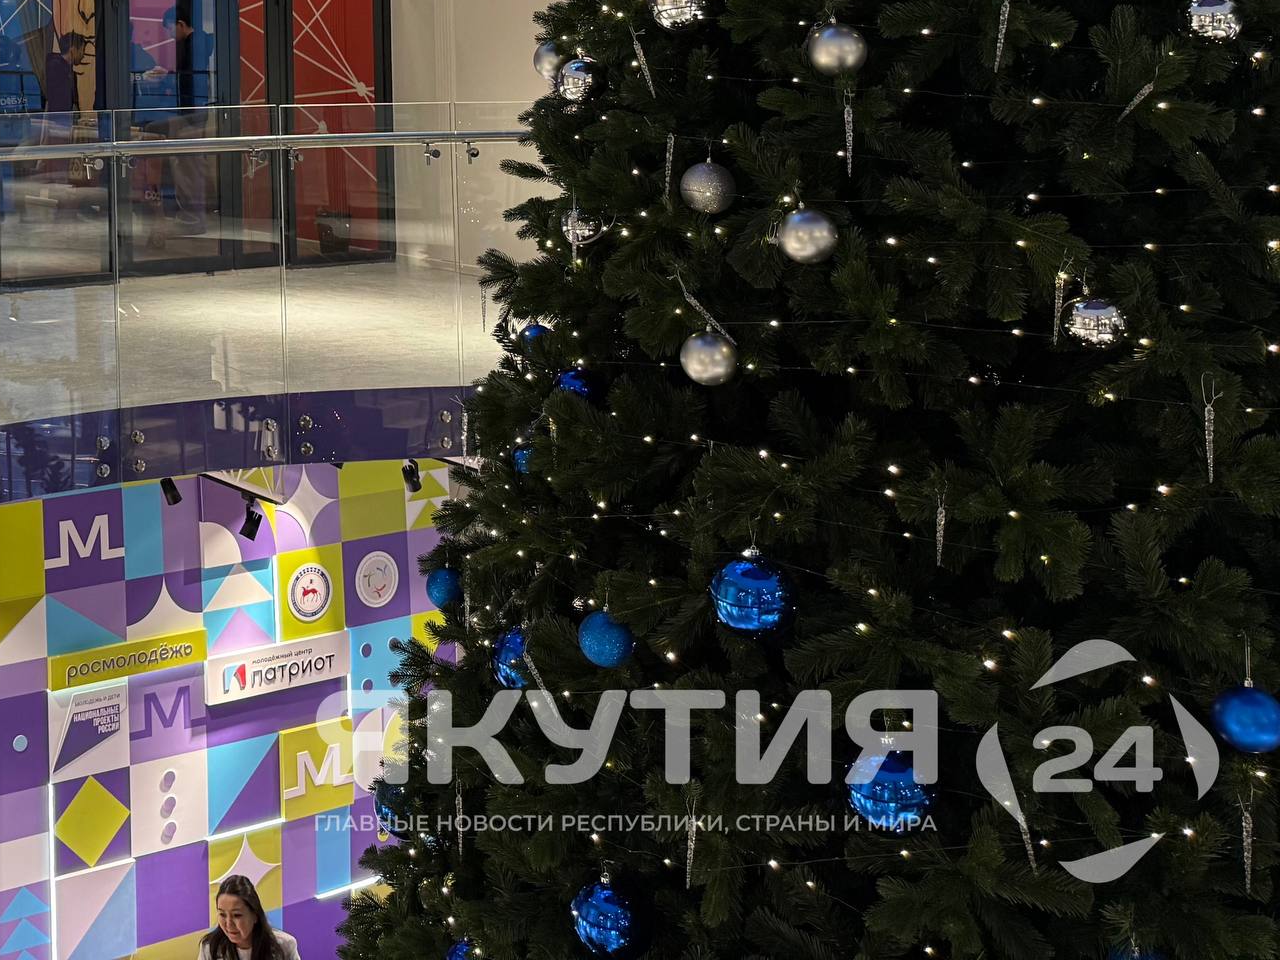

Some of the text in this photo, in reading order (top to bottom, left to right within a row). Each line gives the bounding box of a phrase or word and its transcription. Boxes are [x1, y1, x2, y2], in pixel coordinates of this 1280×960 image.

[66, 642, 193, 688] росмолодёжь
[251, 653, 335, 688] патриот
[73, 705, 119, 722] НАЦИОНАЛЬНЫЕ
[93, 714, 119, 727] ПРОЕКТЫ
